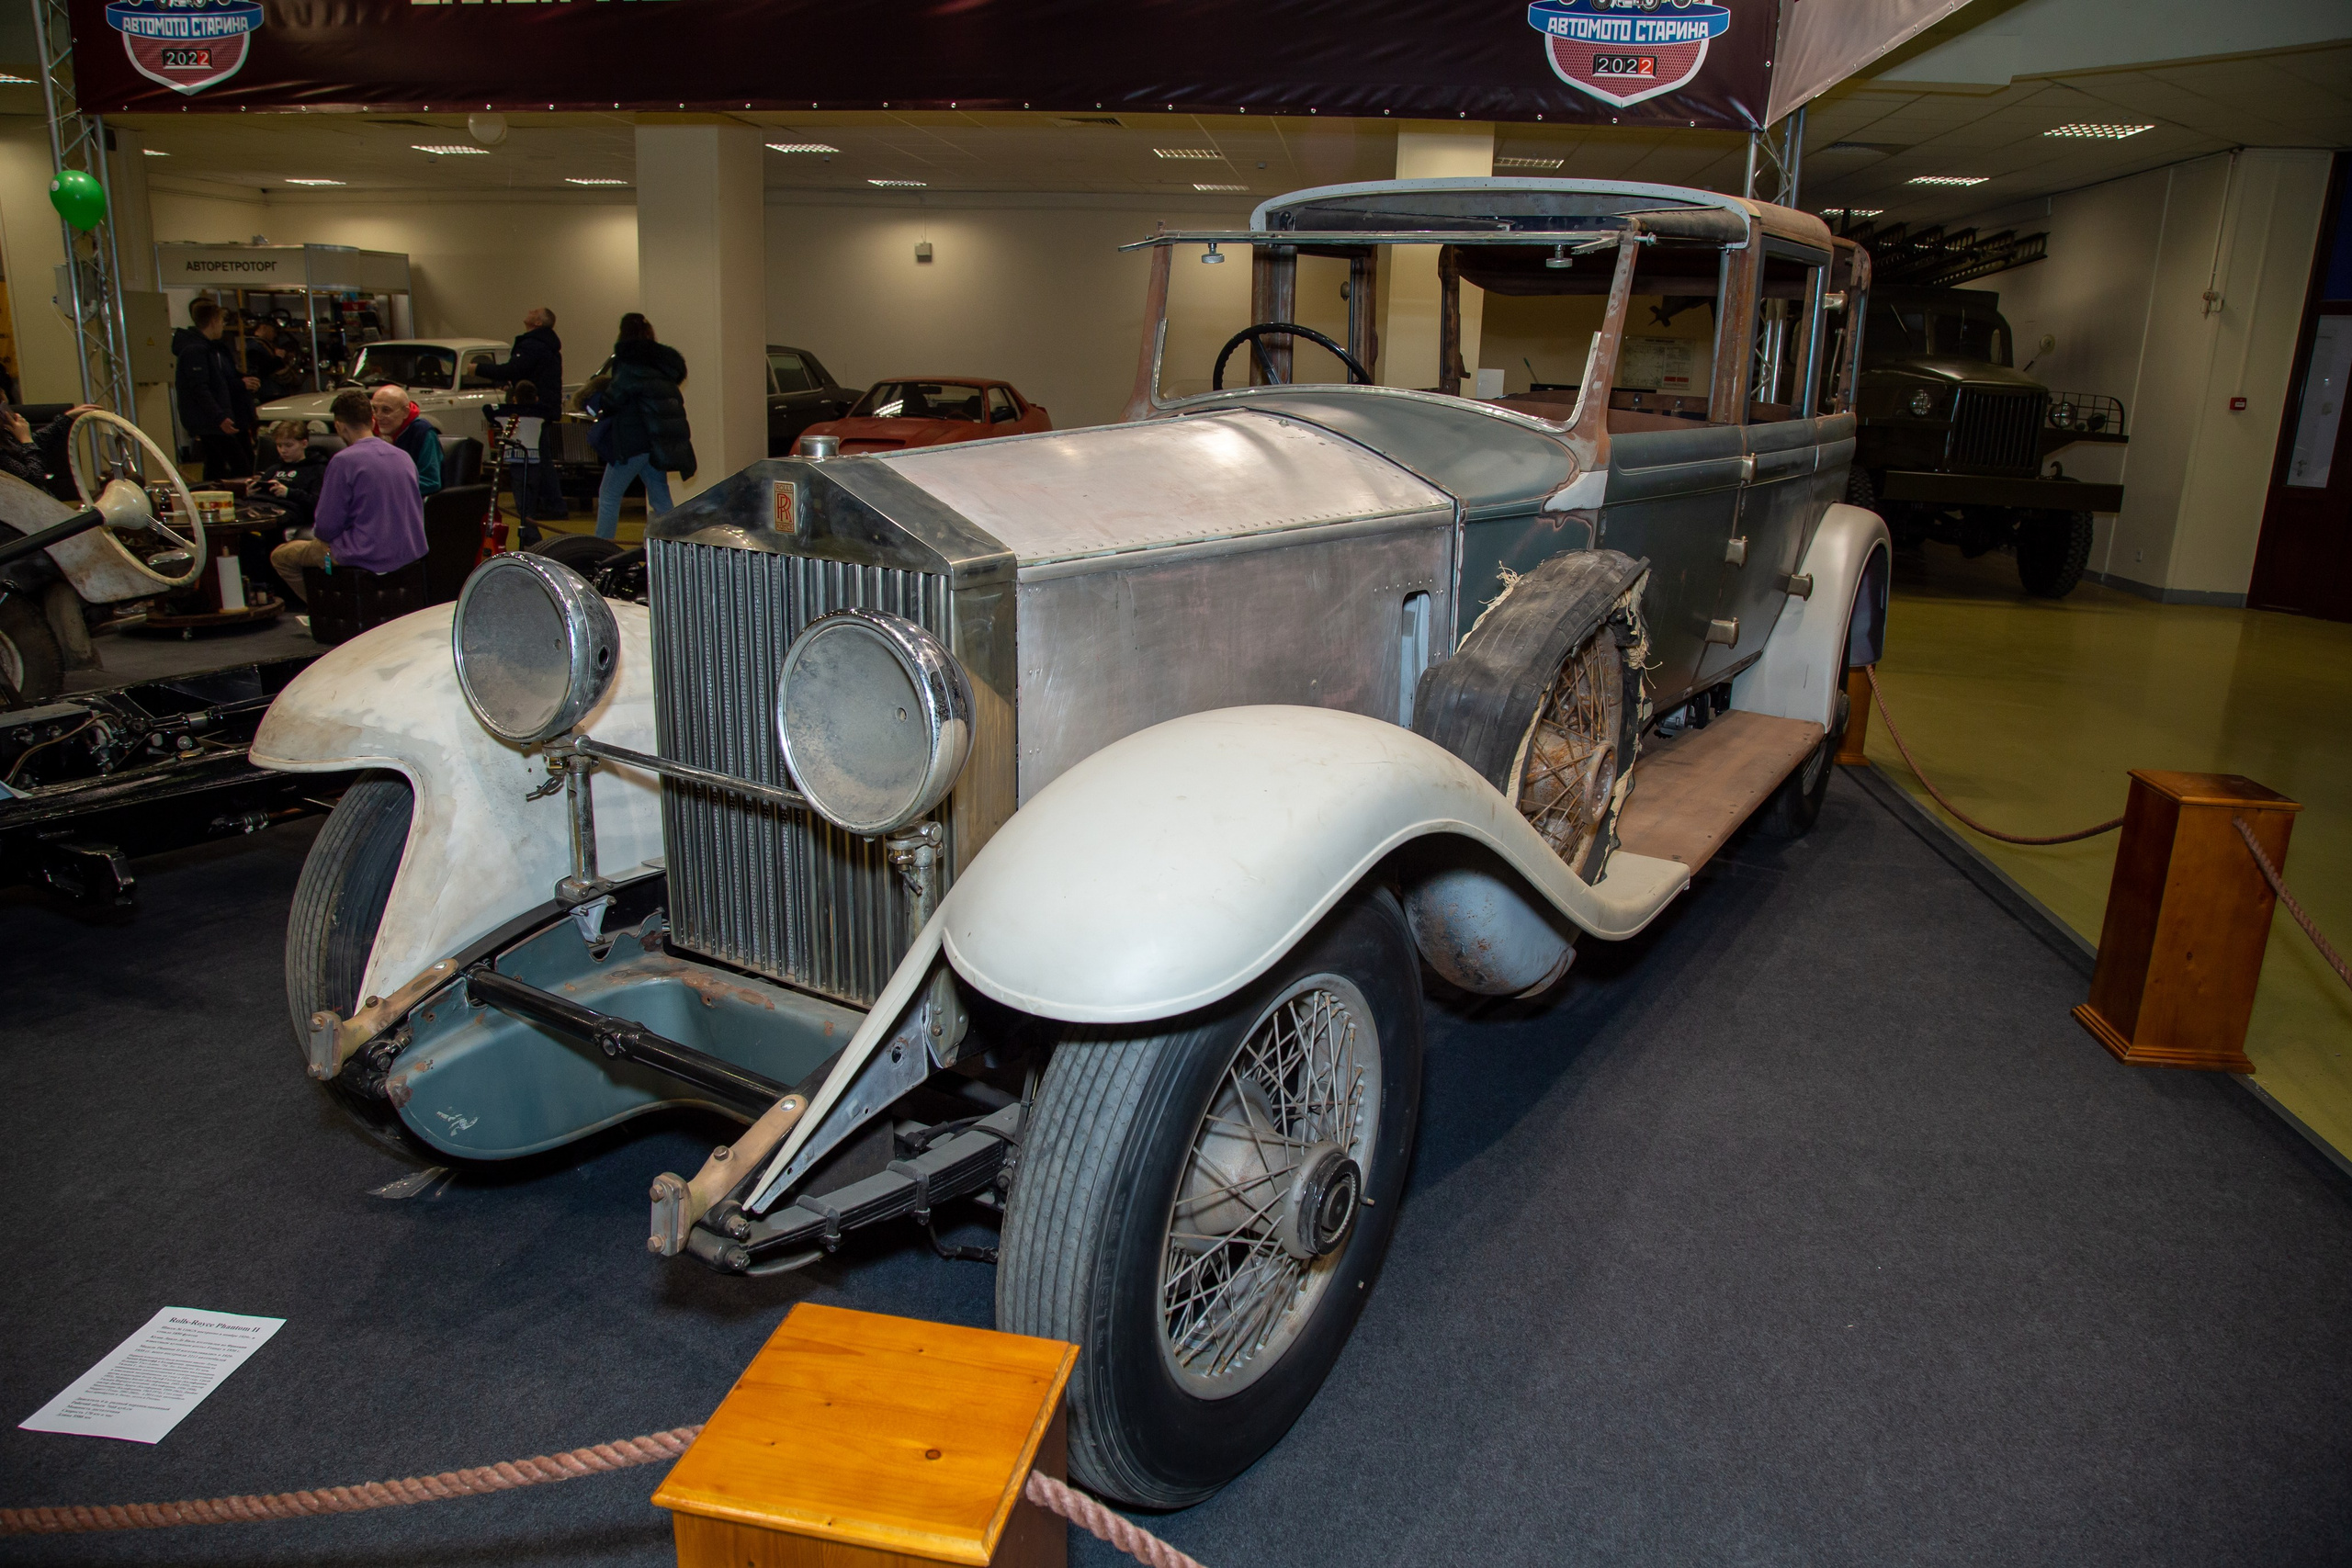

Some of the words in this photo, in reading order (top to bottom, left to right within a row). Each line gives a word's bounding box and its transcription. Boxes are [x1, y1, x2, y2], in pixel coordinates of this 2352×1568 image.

[122, 17, 188, 37] АВТОМОТО
[192, 17, 249, 36] СТАРИНА
[1547, 17, 1631, 41] АВТОМОТО
[1634, 21, 1709, 41] СТАРИНА
[166, 51, 209, 65] 2022
[1597, 57, 1652, 73] 2022
[186, 261, 277, 272] АВТОРЕТРОТОРГ
[1095, 1247, 1117, 1323] LESTER
[168, 1316, 216, 1328] Rolls-Royce
[217, 1323, 252, 1332] Phantom
